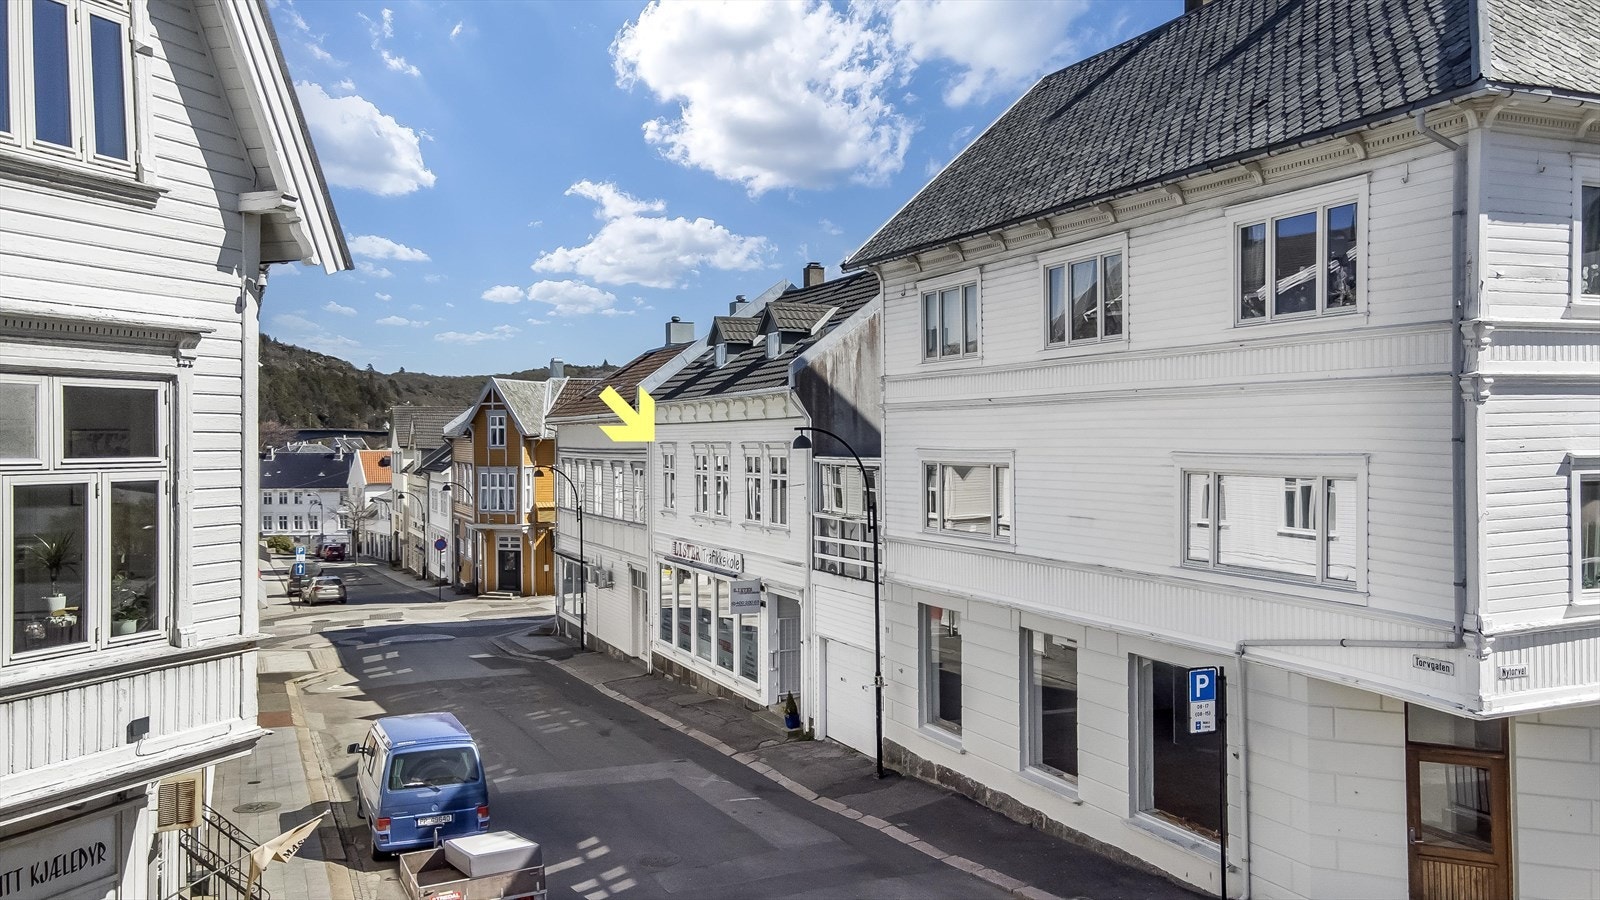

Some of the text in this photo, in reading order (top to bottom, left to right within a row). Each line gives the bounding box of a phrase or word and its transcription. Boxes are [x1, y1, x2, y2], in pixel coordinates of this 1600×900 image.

[673, 541, 740, 571] LISTER Trafikkskole
[1416, 657, 1450, 672] Torvgaten
[1196, 674, 1209, 698] P
[30, 841, 106, 887] KJÆLEDYR
